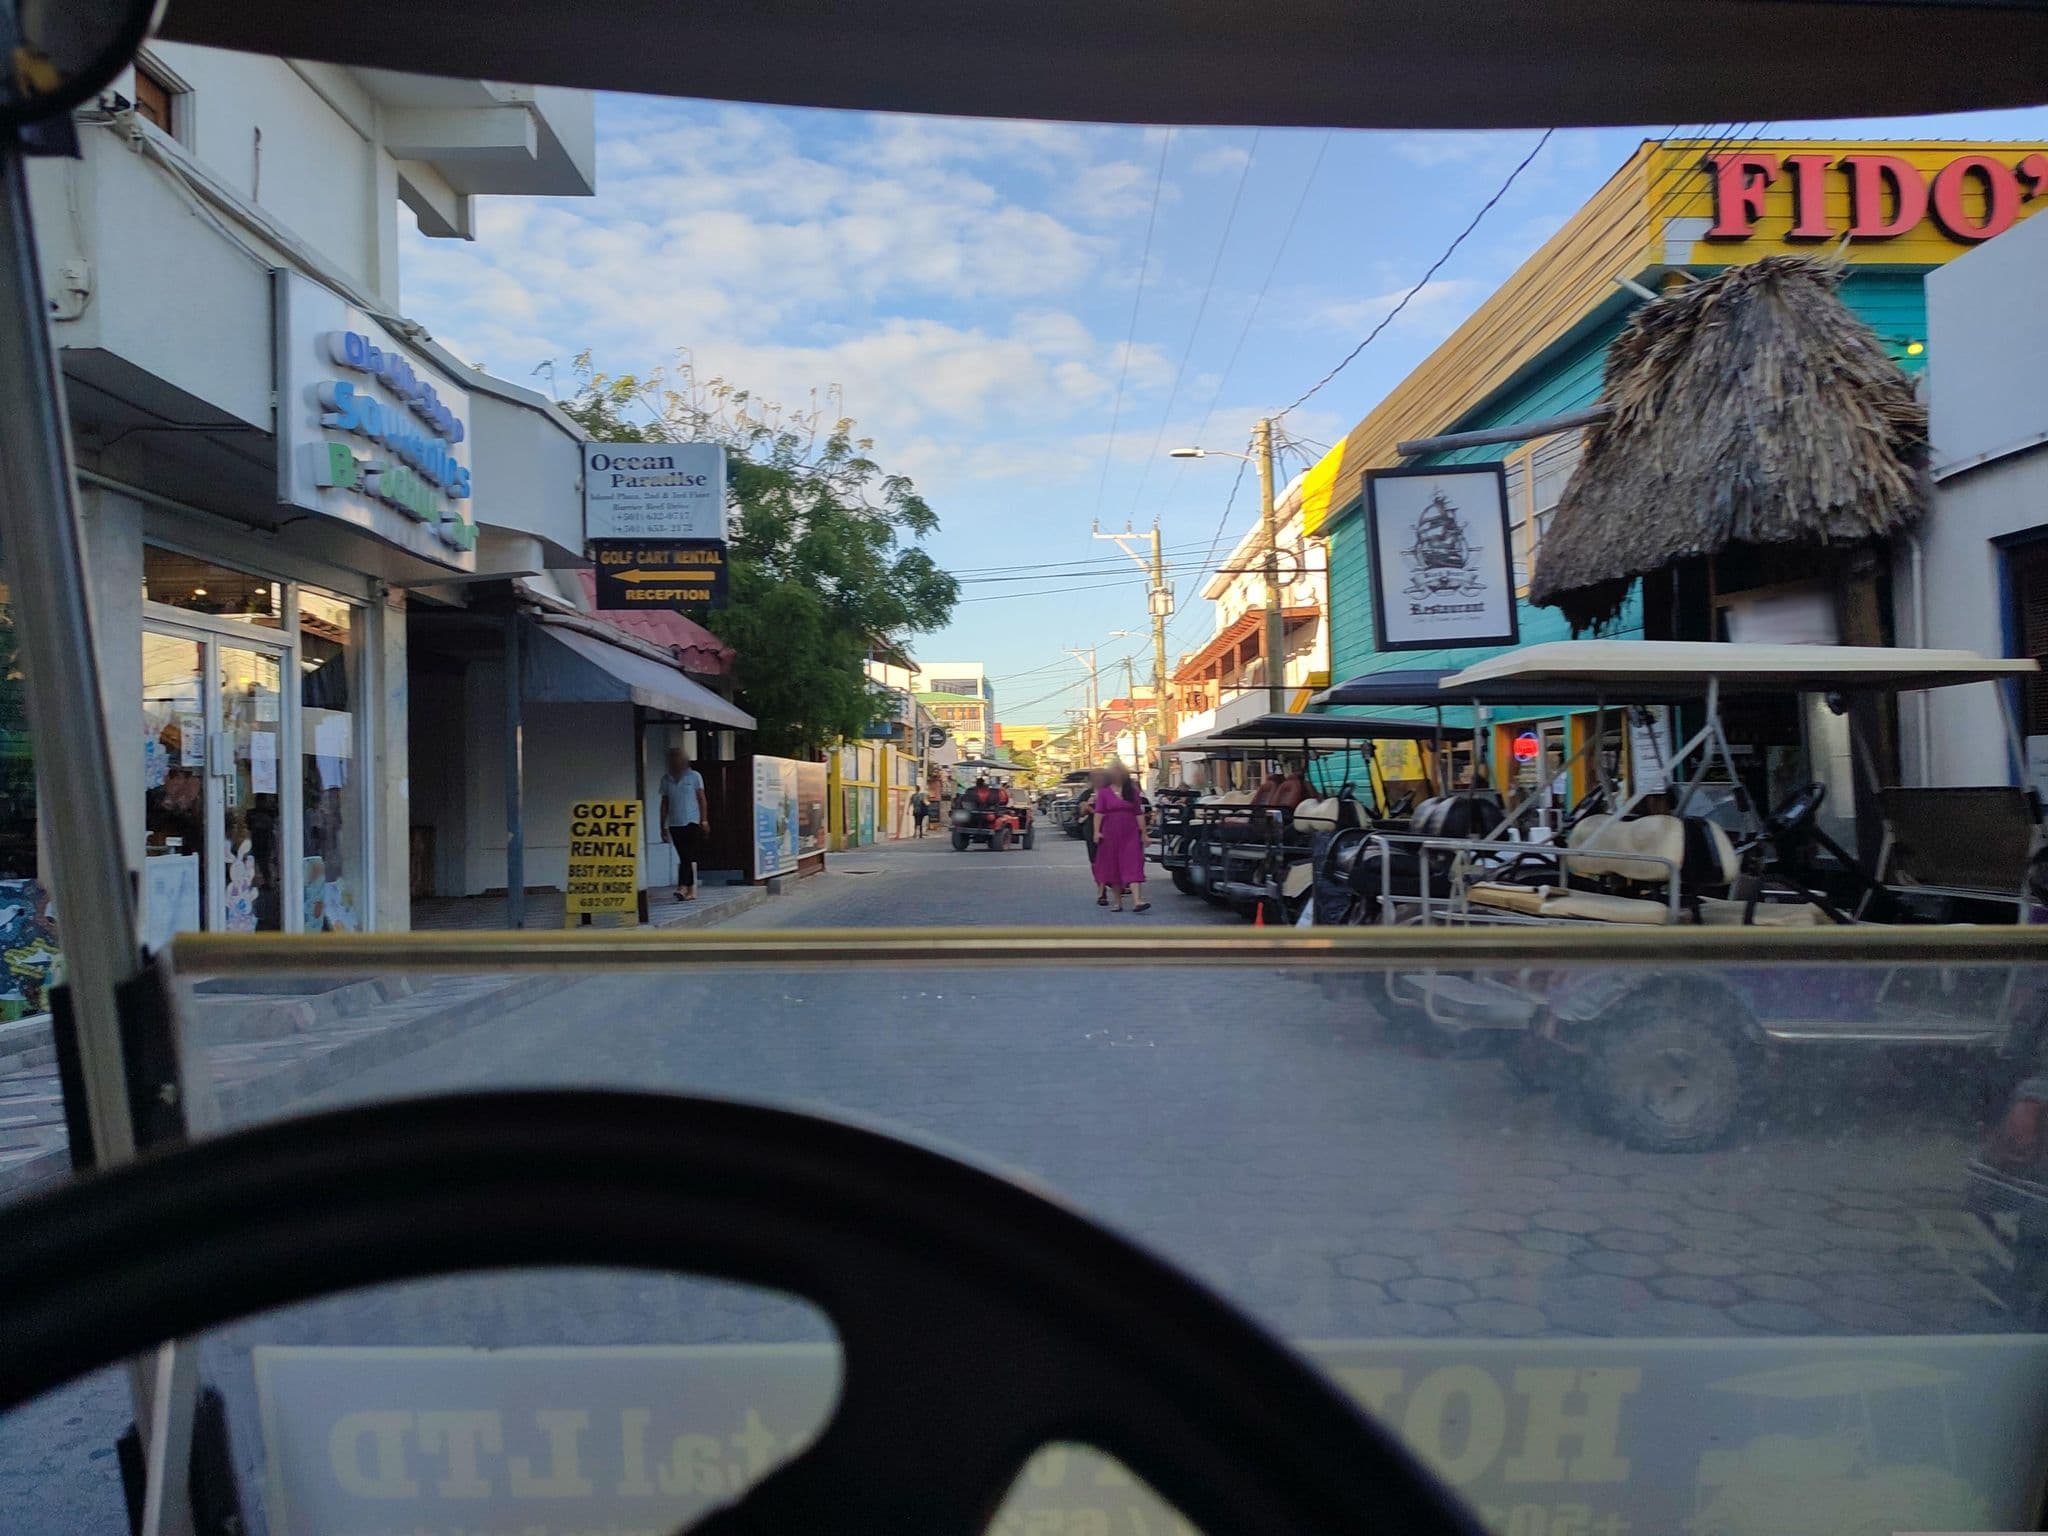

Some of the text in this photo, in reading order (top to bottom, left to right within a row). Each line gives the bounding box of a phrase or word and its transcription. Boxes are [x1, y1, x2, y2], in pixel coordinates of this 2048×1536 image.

[591, 453, 675, 471] Ocean
[610, 471, 707, 488] Paradise
[600, 550, 722, 565] GOLF CART RENTAL
[625, 589, 710, 600] RECEPTION
[573, 804, 637, 819] GOLF
[571, 822, 636, 837] CART
[571, 841, 636, 857] RENTAL
[568, 865, 634, 878] BEST PRICES
[567, 882, 633, 895] CHECK INSIDE
